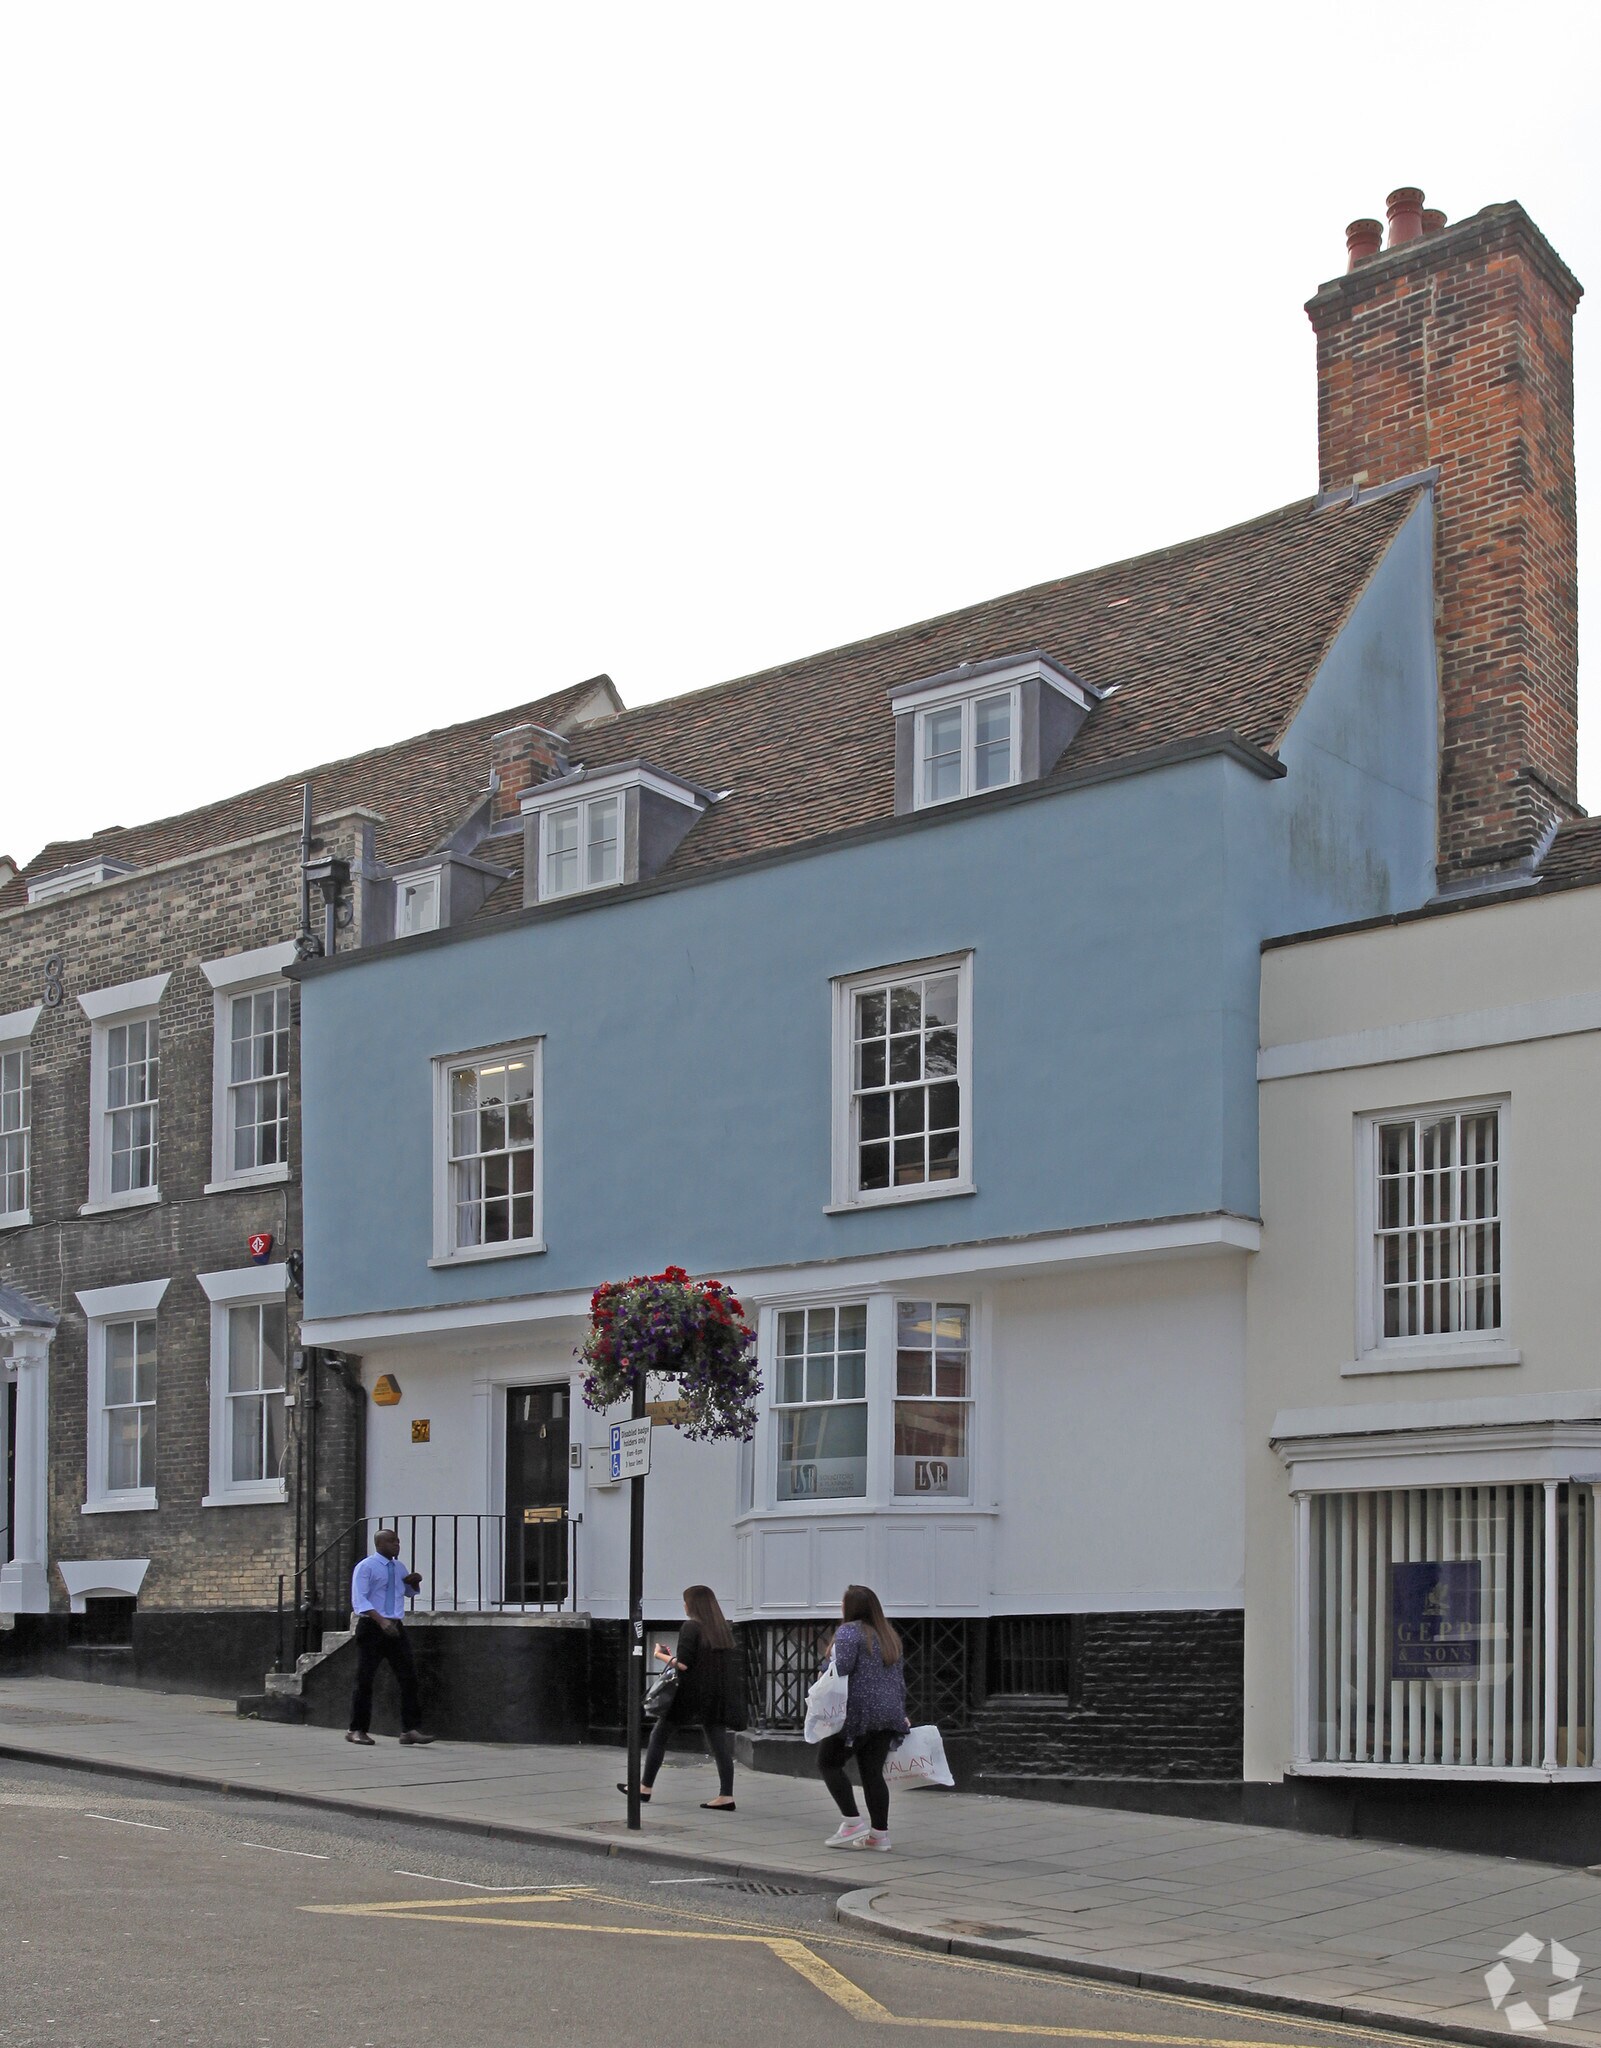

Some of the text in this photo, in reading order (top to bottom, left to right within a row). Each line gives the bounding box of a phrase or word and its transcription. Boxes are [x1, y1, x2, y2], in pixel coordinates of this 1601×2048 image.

[412, 1421, 429, 1440] 57
[613, 1430, 619, 1449] P
[621, 1427, 649, 1438] Disabled badge
[624, 1436, 646, 1447] holders only
[915, 1460, 949, 1491] LSR
[1397, 1621, 1473, 1642] GEPP
[1398, 1646, 1472, 1662] & SONS
